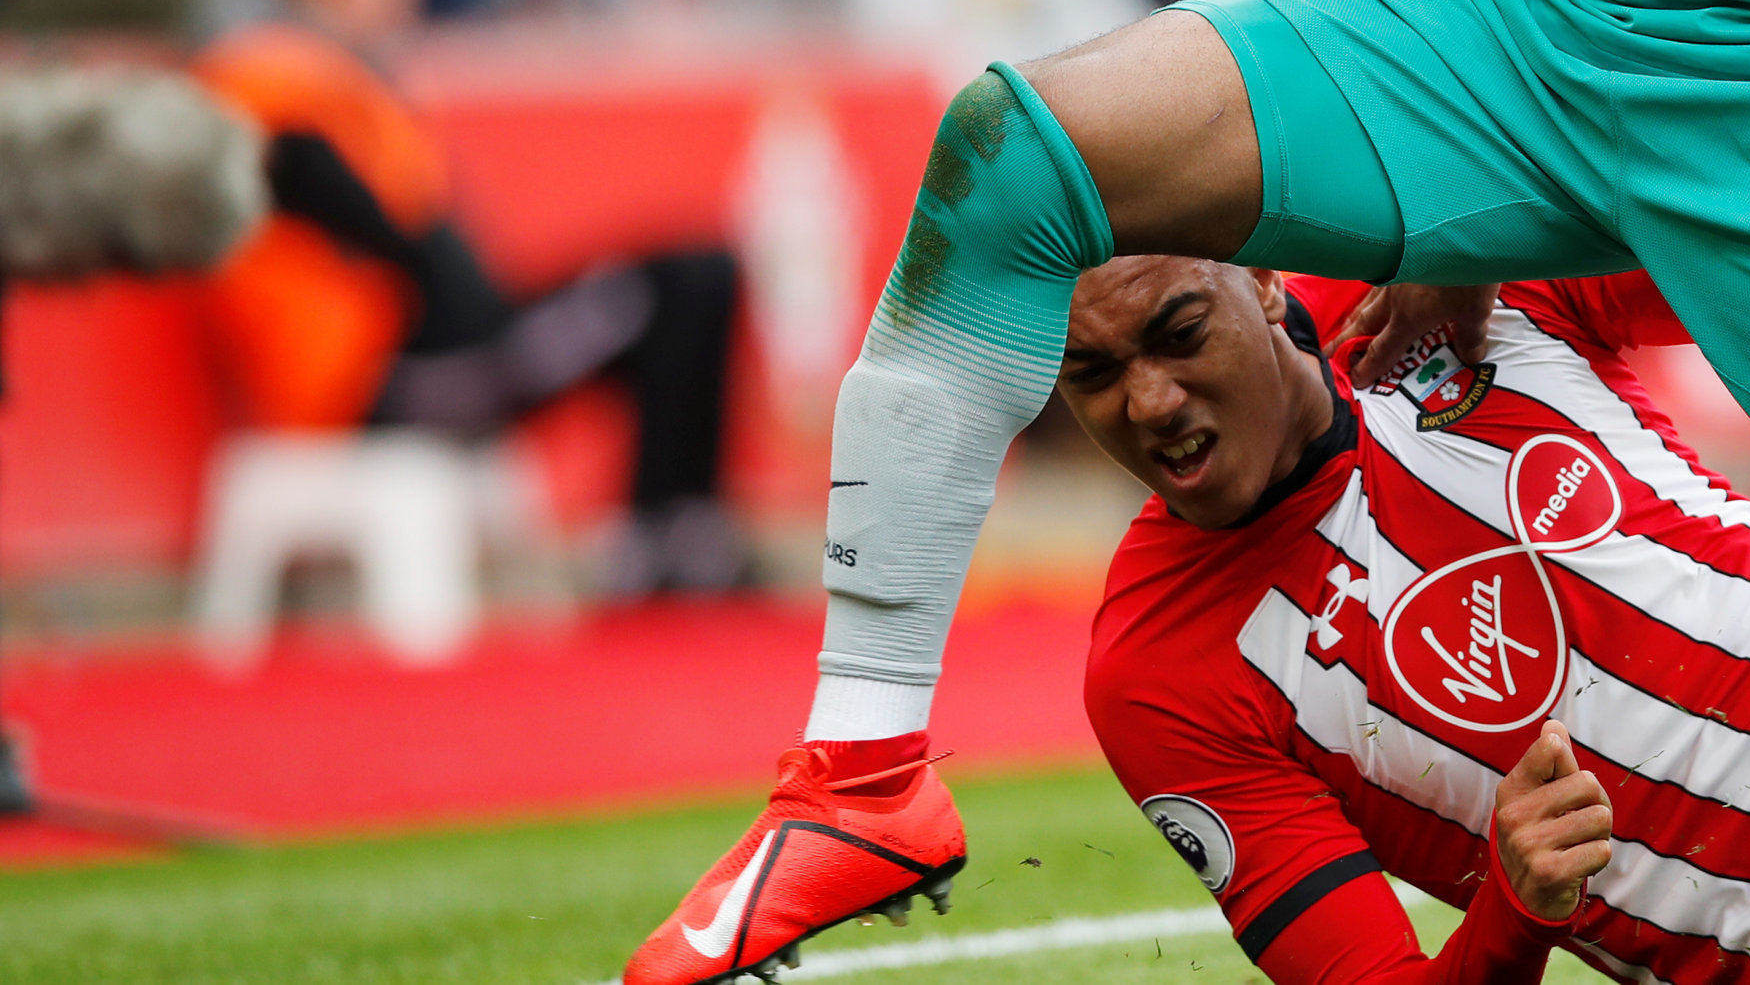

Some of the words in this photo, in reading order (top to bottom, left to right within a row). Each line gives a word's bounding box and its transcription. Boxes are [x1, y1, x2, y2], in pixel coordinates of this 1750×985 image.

[1421, 383, 1487, 428] SOUTHAMPTON
[1480, 367, 1492, 382] FC
[1531, 456, 1592, 535] media
[824, 537, 858, 567] URS
[1421, 574, 1540, 703] Virgin
